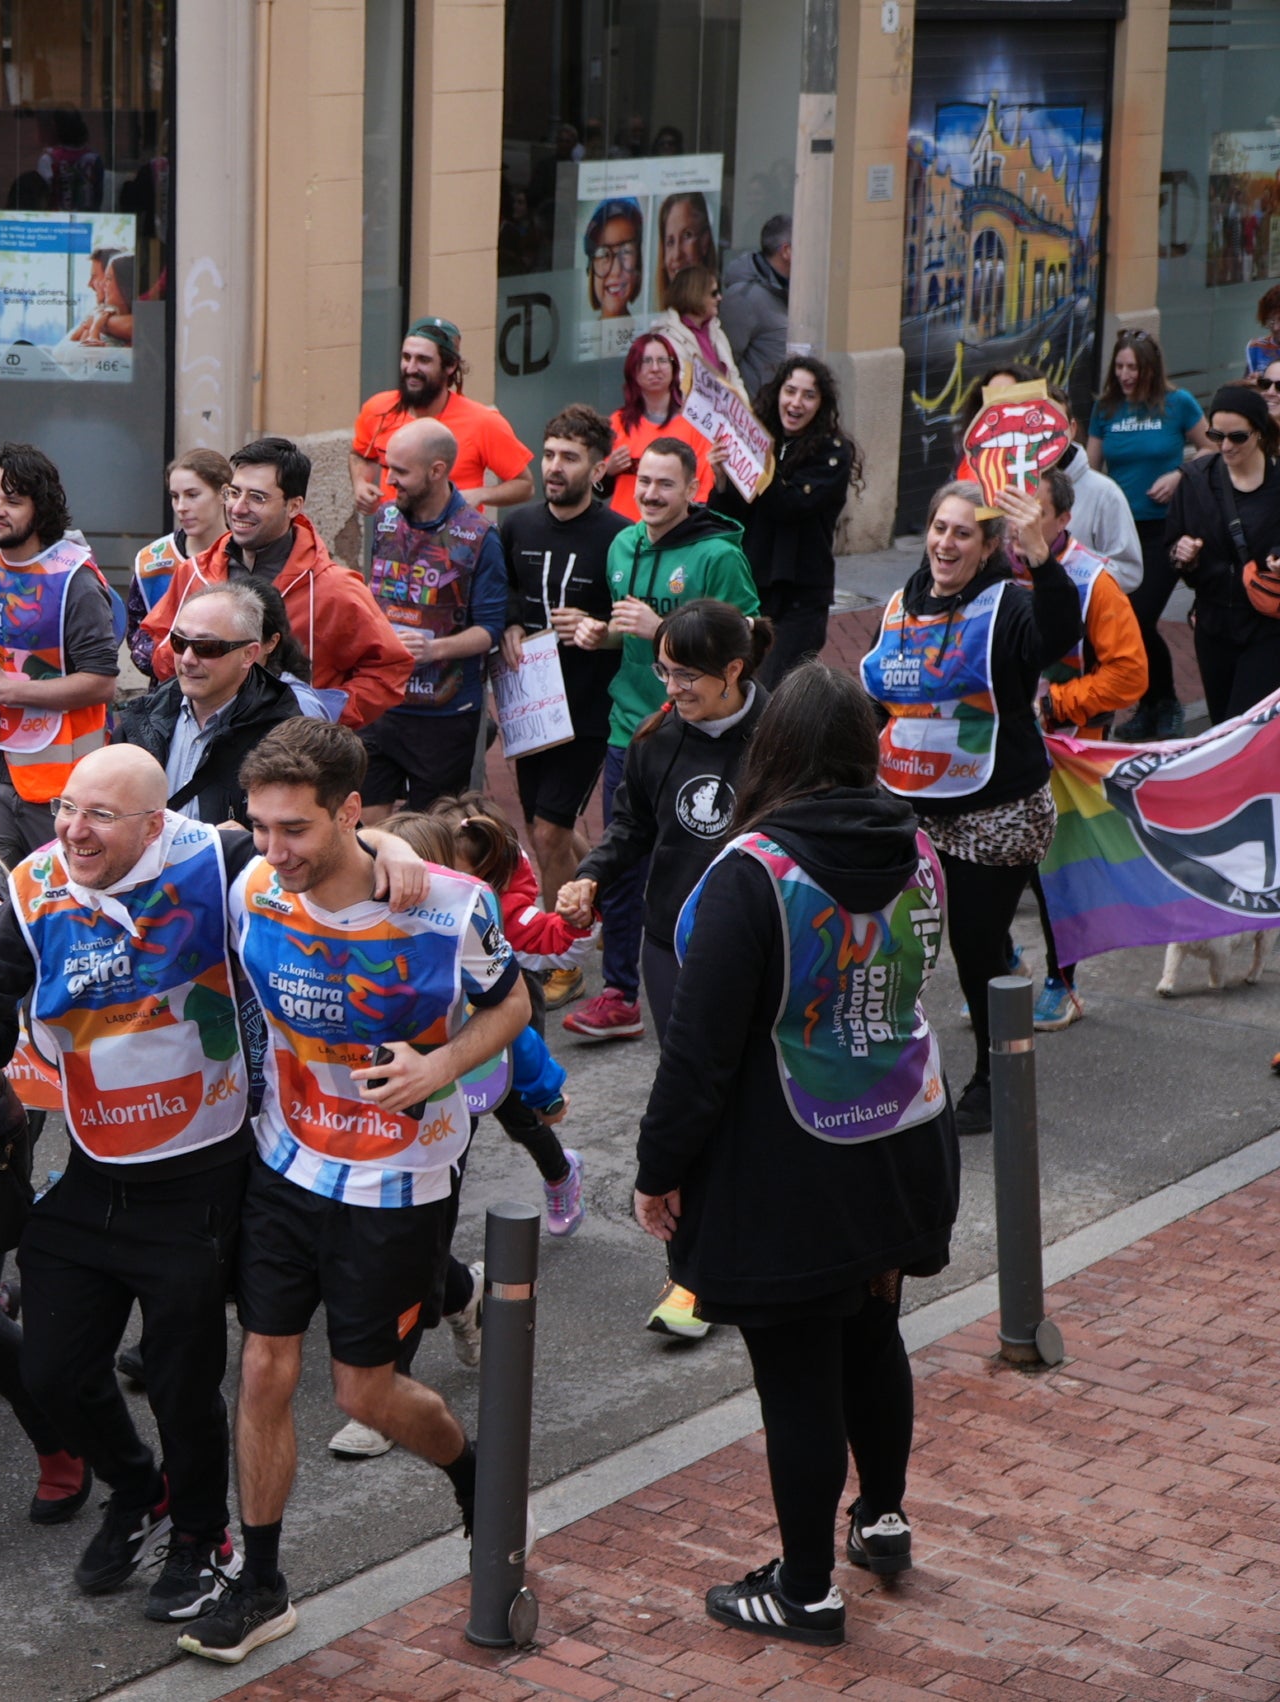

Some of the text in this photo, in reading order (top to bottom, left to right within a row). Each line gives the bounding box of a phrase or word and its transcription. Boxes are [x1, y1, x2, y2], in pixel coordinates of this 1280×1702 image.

[95, 361, 119, 372] 46€
[883, 670, 920, 691] gara
[21, 715, 51, 731] aek
[948, 762, 980, 779] aek
[171, 829, 208, 847] eitb
[417, 907, 456, 928] eitb
[269, 972, 343, 1003] Euskara
[278, 963, 324, 981] 24.korrika
[278, 994, 345, 1022] gara
[844, 968, 869, 1058] Euskara
[865, 965, 893, 1042] gara
[831, 992, 847, 1047] 24.korrika
[203, 1069, 242, 1106] aek
[79, 1092, 188, 1127] 24.korrika
[289, 1101, 404, 1140] 24.korrika
[813, 1099, 899, 1130] korrika.eus
[418, 1106, 458, 1147] aek
